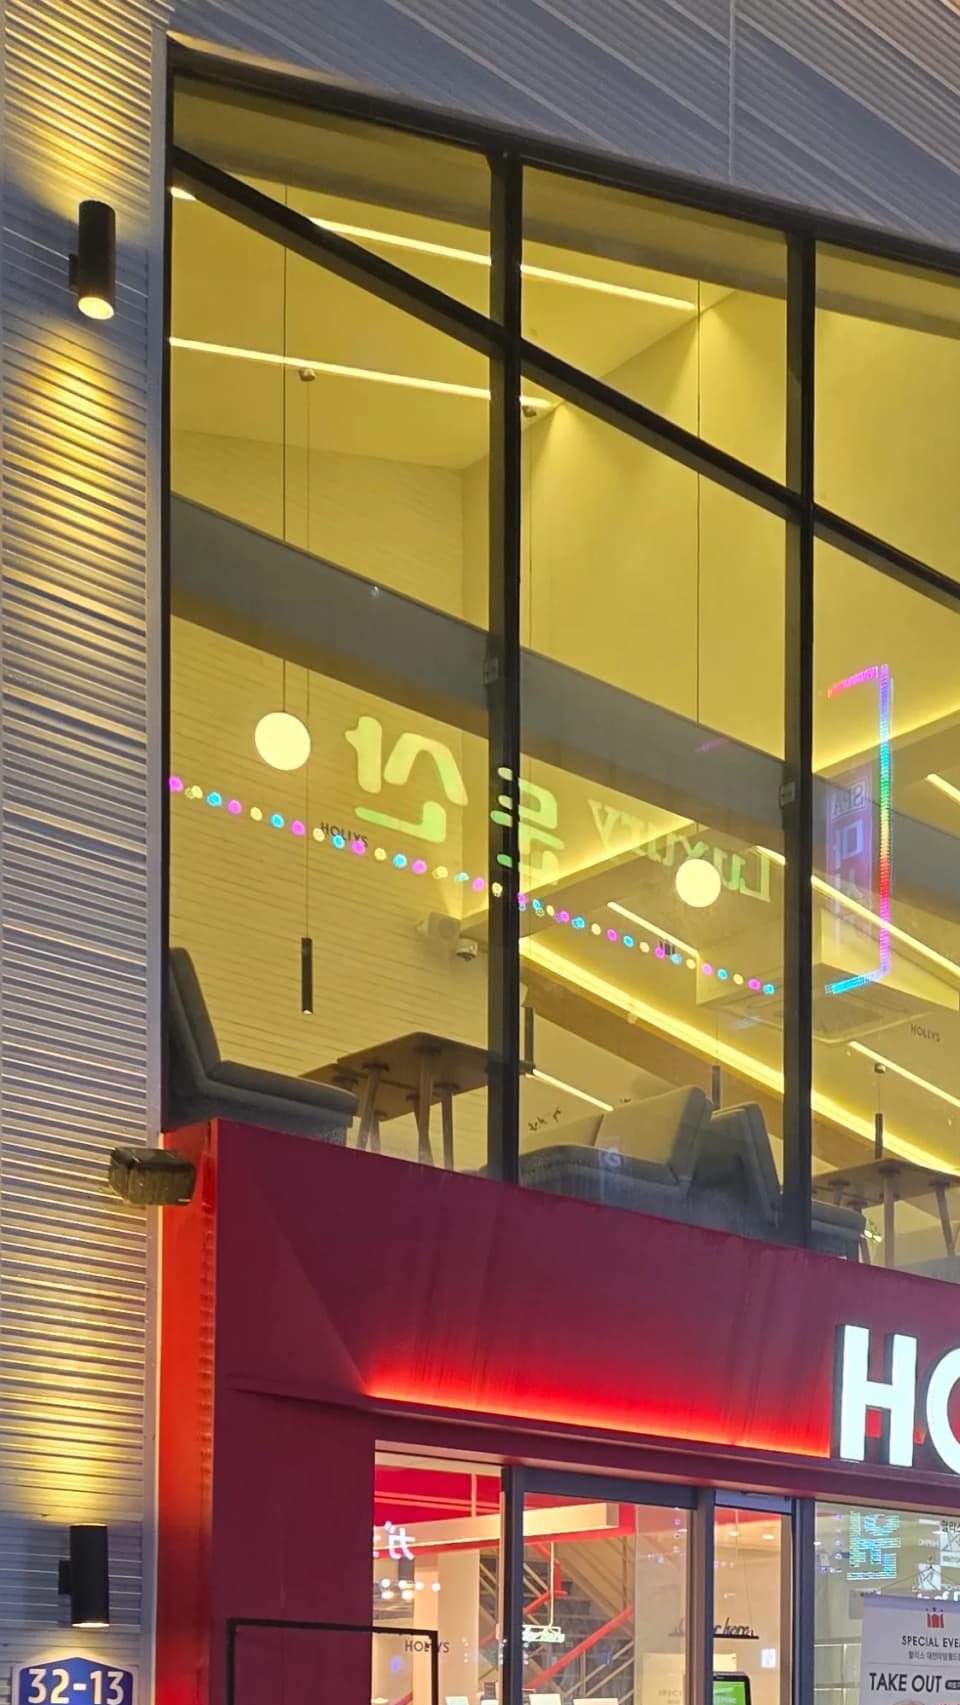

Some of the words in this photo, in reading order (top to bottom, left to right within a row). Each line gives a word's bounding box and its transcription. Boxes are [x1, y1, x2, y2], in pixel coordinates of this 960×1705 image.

[902, 1635, 939, 1648] SPECIAL
[28, 1668, 125, 1705] 32-13
[869, 1672, 908, 1692] TAKE
[911, 1674, 942, 1693] OUT
